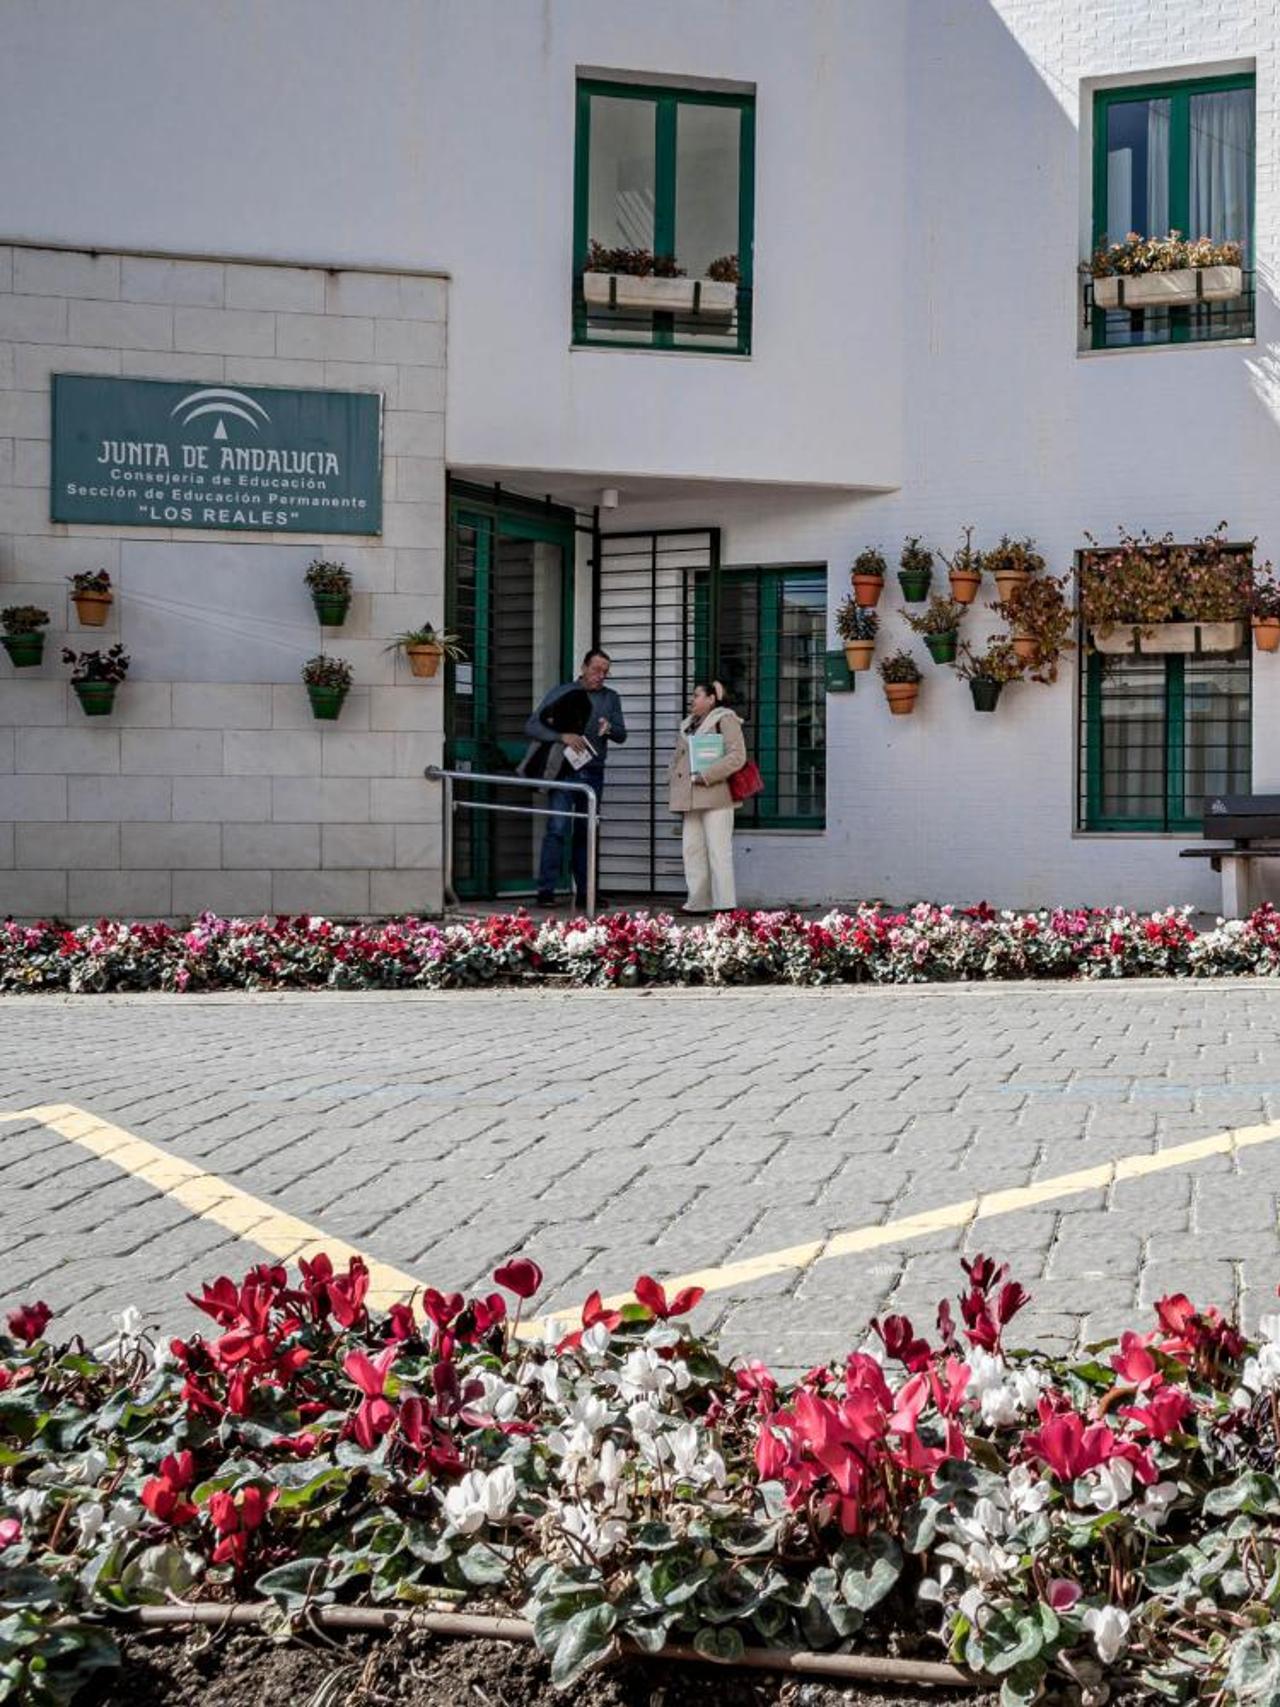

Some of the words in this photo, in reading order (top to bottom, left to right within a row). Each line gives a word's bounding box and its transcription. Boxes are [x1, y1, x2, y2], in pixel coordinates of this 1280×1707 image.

[97, 440, 170, 467] JUNTA
[181, 445, 209, 469] DE
[212, 474, 232, 486] de
[238, 475, 327, 490] Educación
[67, 483, 137, 498] Sección
[144, 488, 165, 500] de
[172, 489, 261, 503] Educación
[268, 493, 367, 509] Permanente
